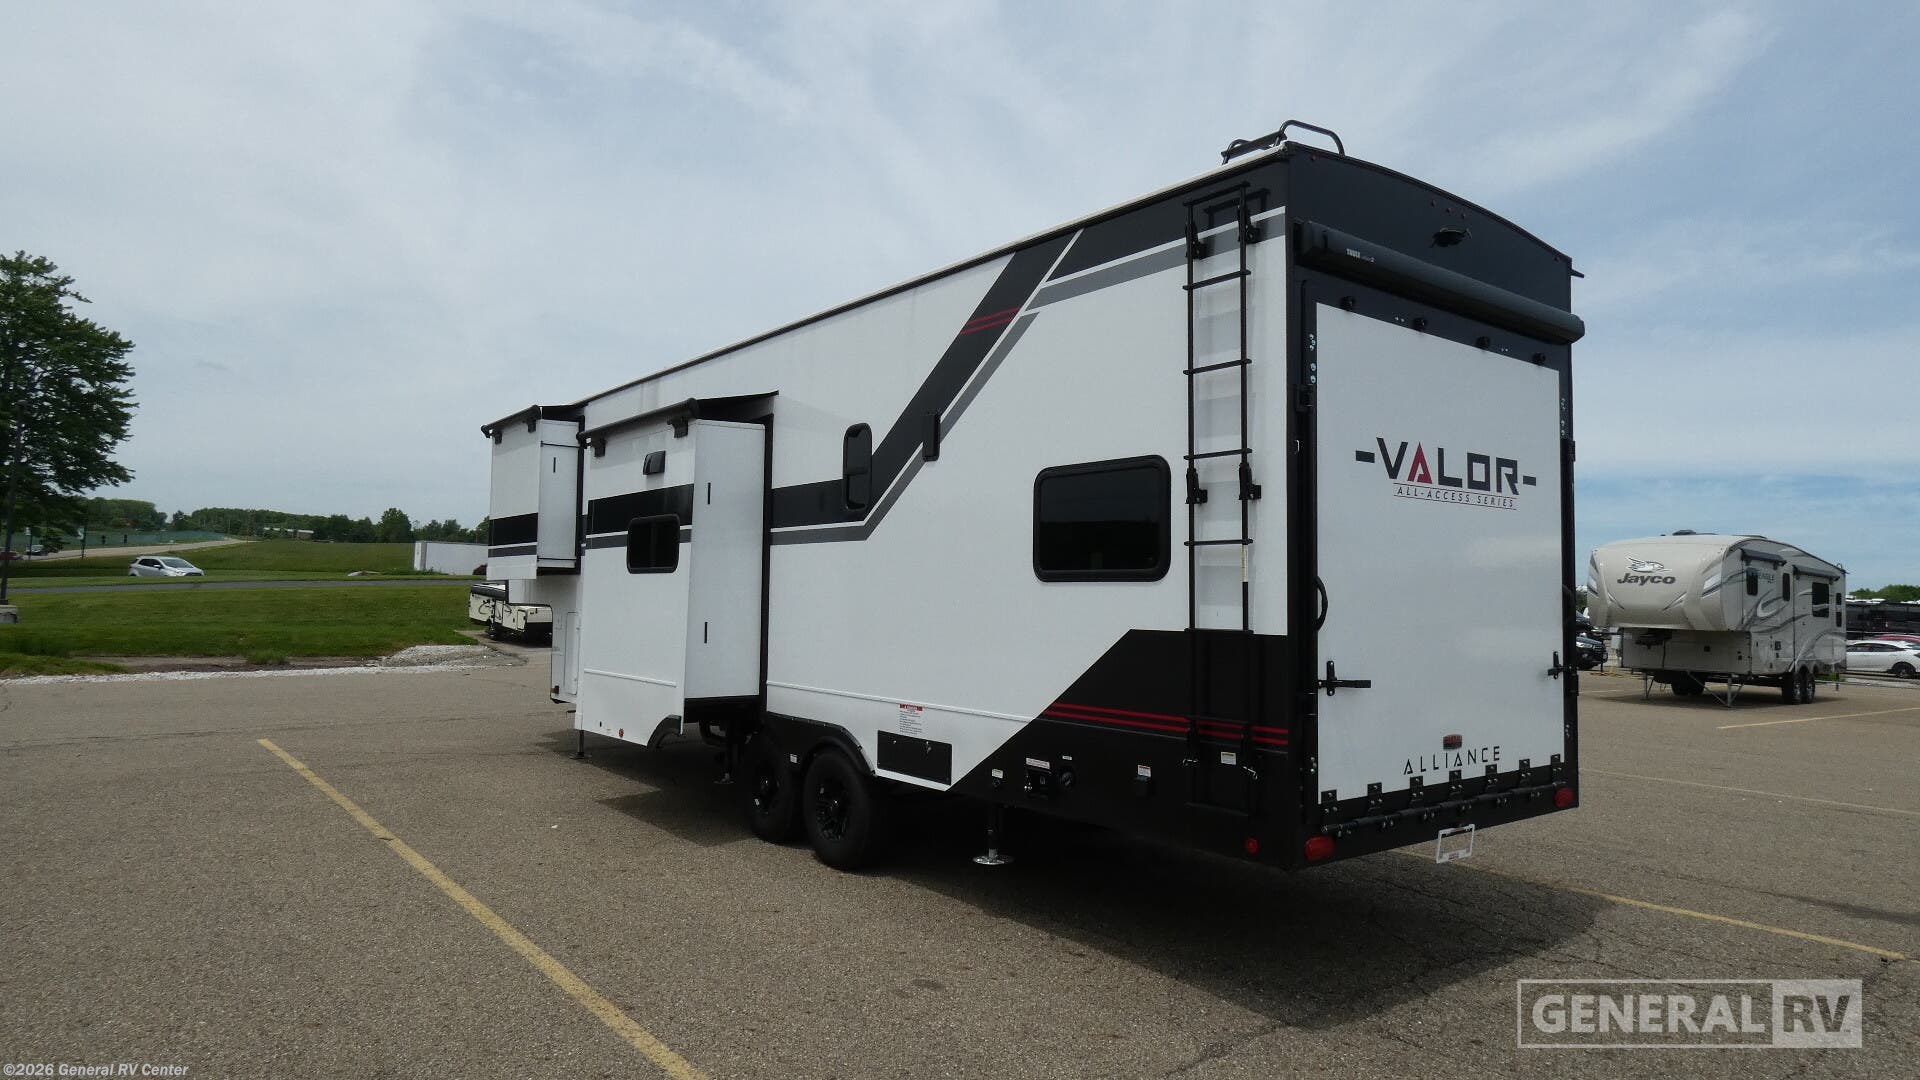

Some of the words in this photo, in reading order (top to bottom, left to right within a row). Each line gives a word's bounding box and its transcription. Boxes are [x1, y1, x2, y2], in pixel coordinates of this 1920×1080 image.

[1397, 486, 1470, 503] ALL-ACCESS
[1477, 495, 1514, 508] SERIES
[1616, 572, 1676, 586] Jayco
[1403, 745, 1500, 775] ALLIANCE
